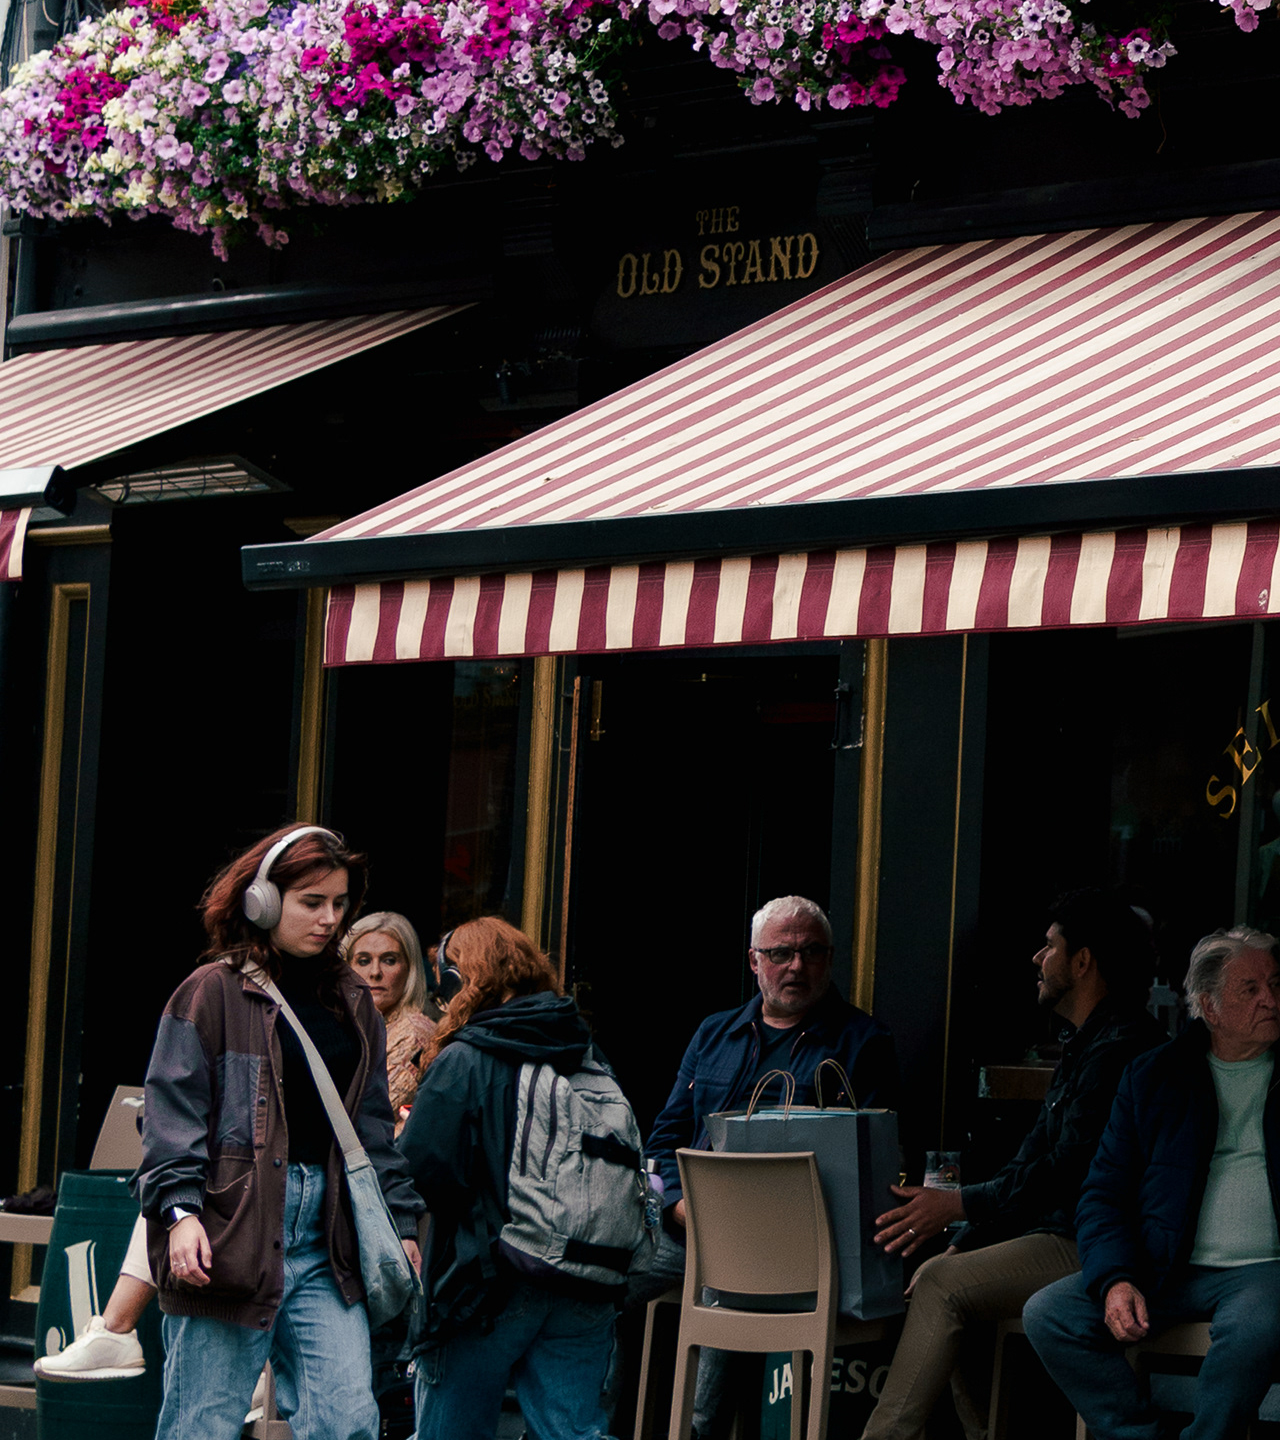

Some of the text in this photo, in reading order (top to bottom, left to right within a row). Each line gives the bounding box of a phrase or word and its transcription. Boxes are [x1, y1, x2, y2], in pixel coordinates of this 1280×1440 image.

[696, 206, 740, 236] THE
[616, 232, 820, 300] OLD STAND
